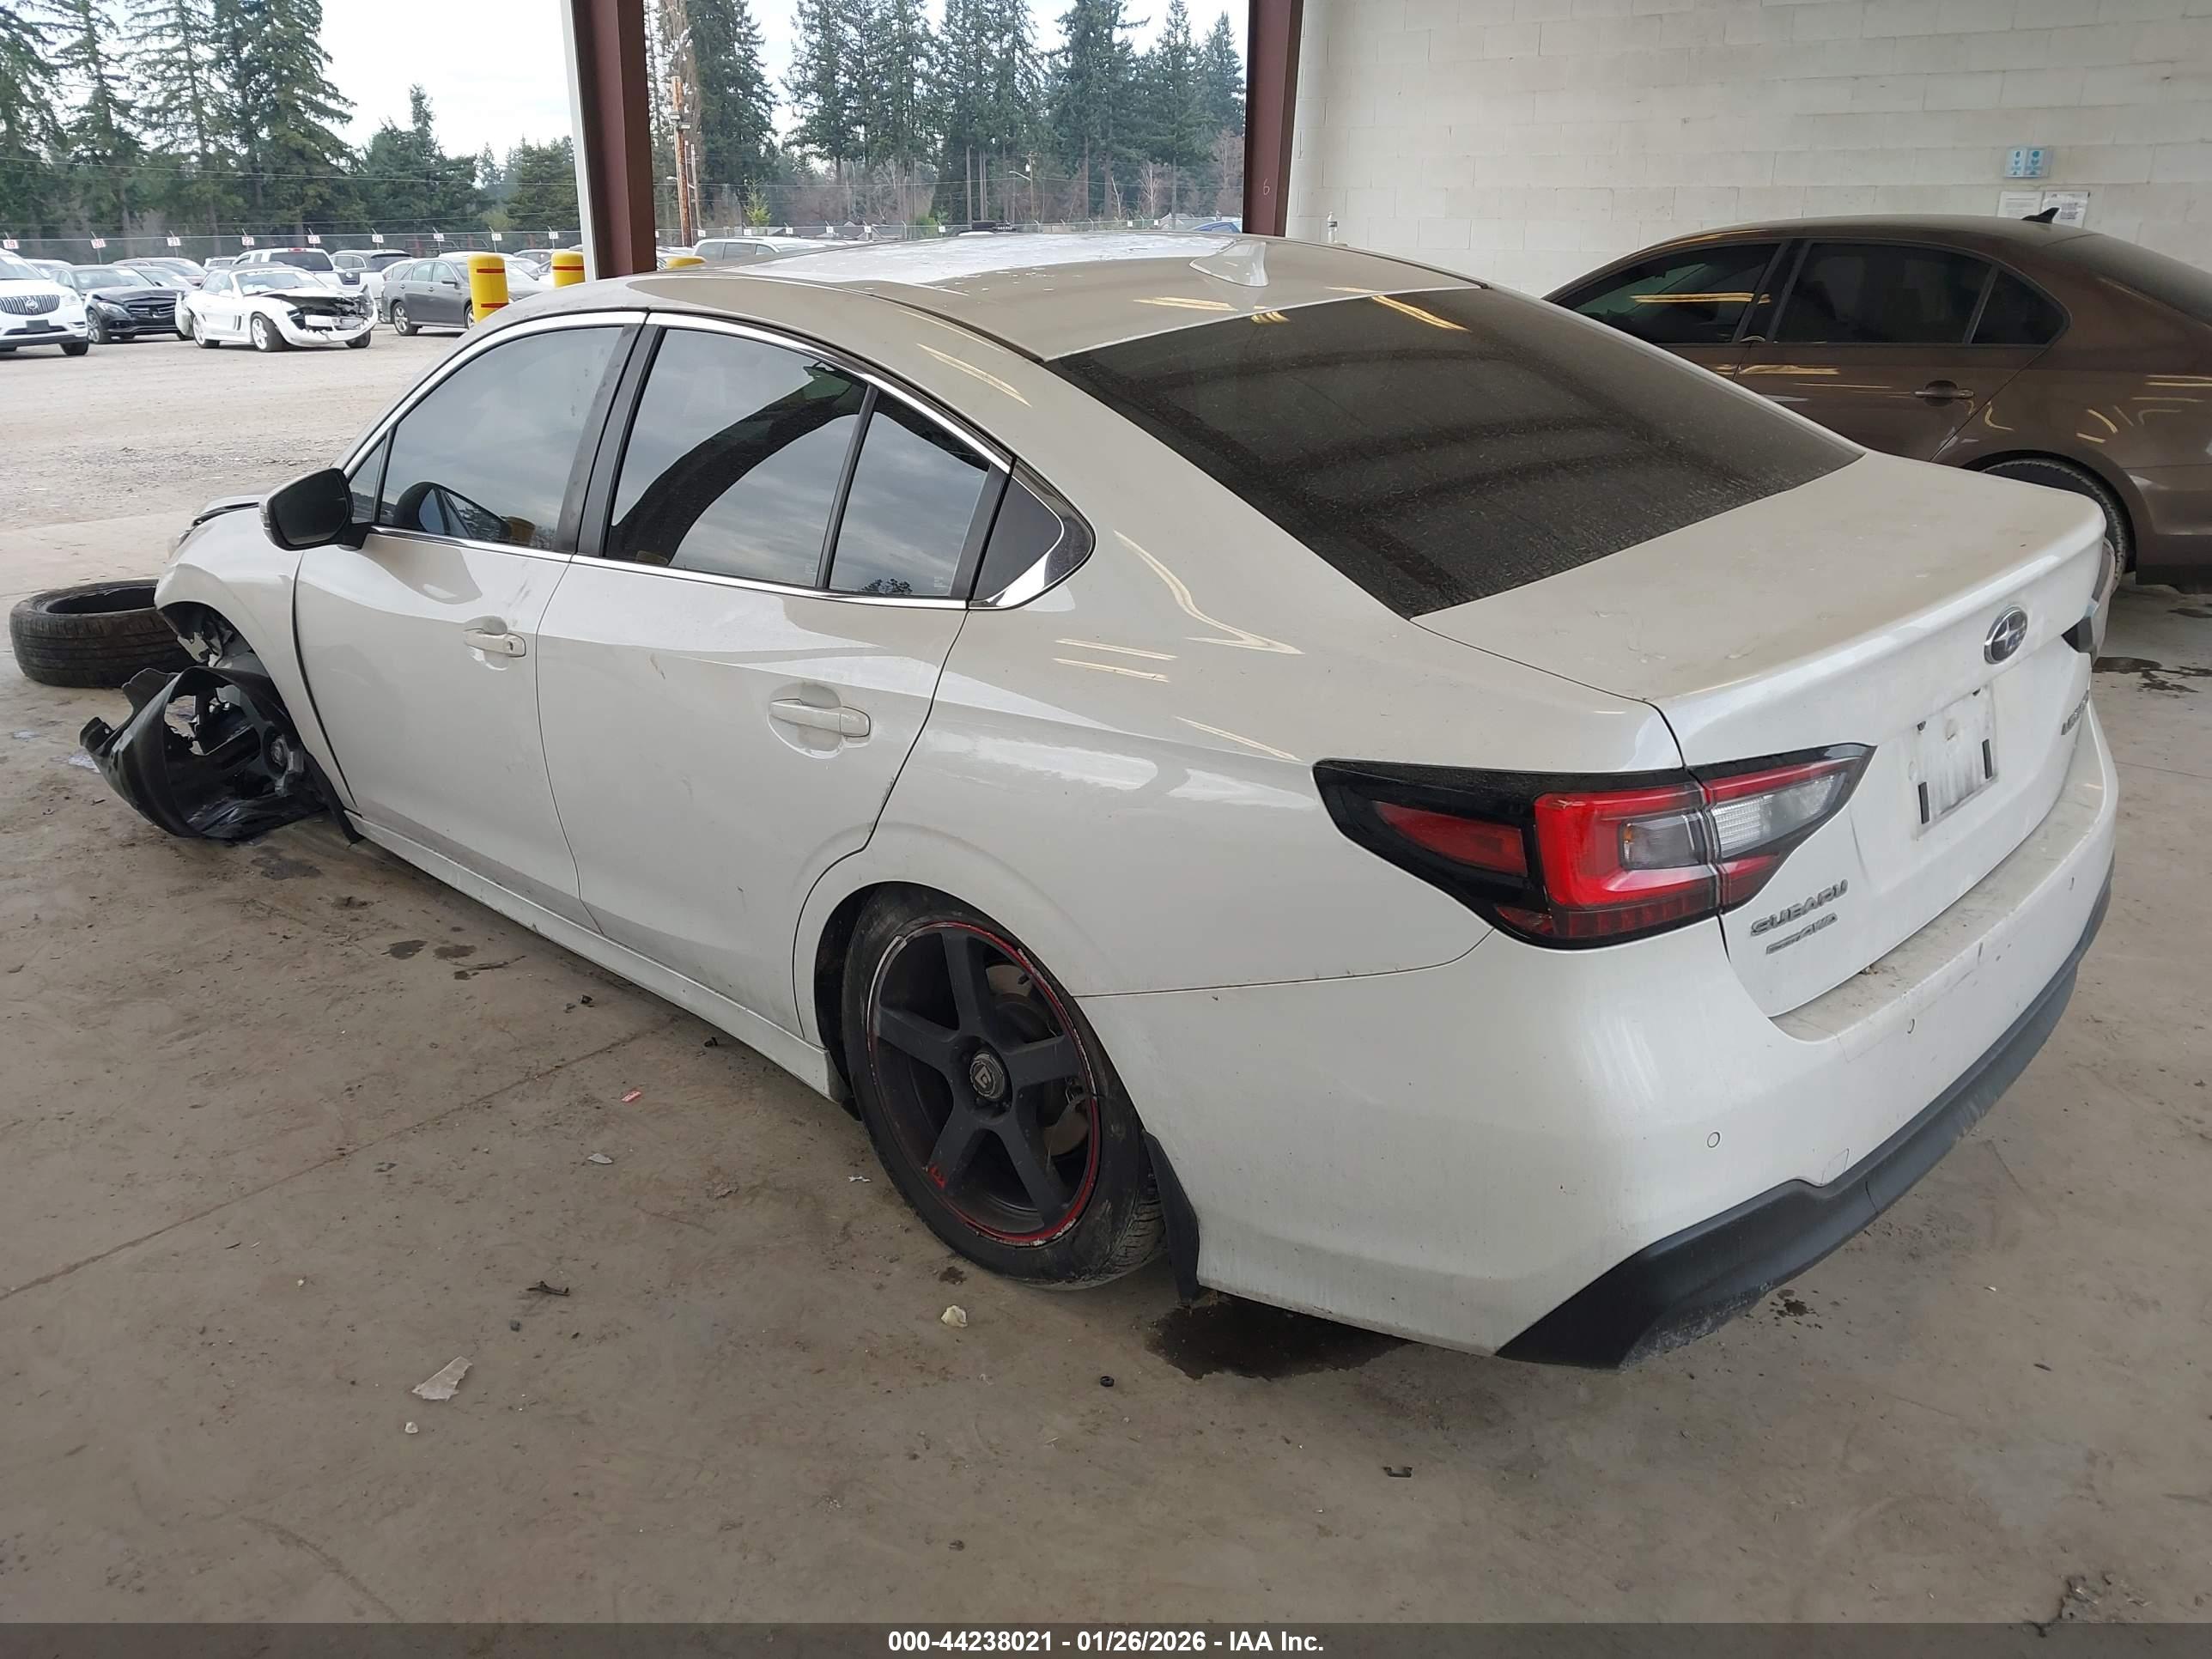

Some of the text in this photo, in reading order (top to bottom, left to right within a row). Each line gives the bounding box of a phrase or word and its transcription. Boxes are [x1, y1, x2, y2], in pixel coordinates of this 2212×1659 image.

[1263, 179, 1270, 195] 6
[6, 240, 15, 248] 19
[1750, 878, 1849, 937] SUBARU
